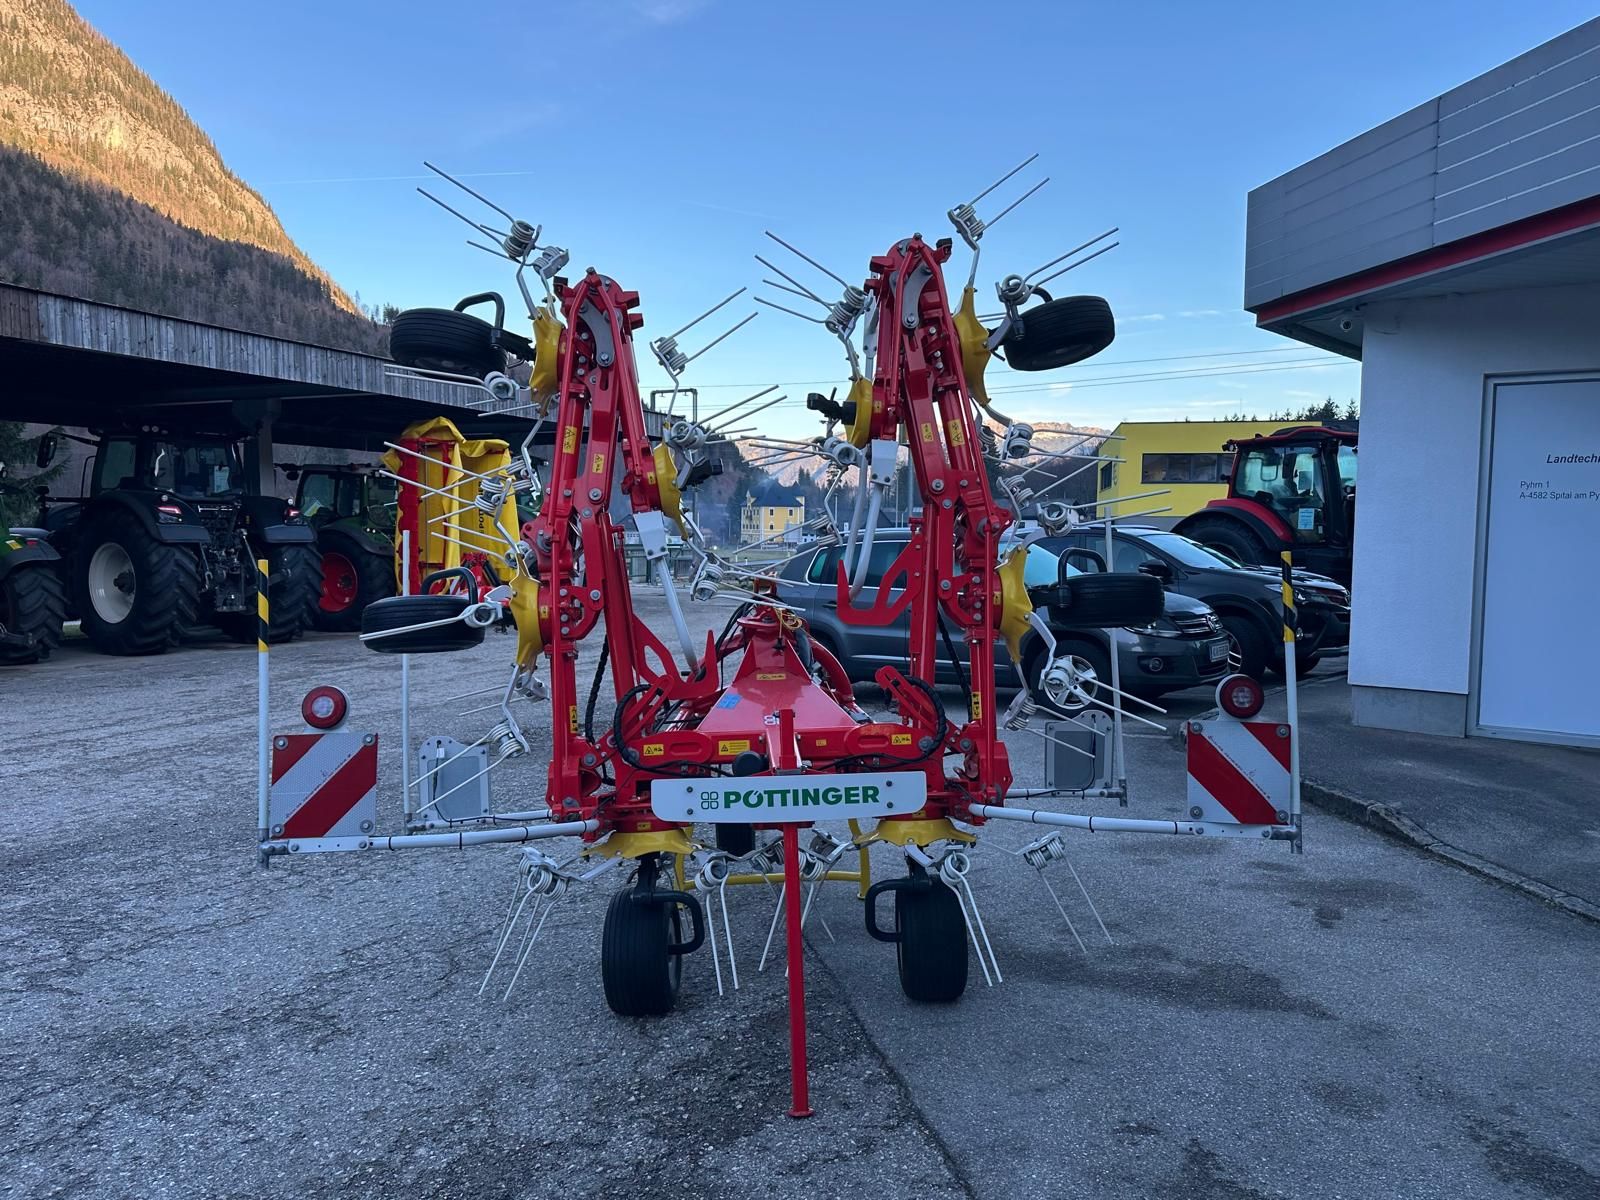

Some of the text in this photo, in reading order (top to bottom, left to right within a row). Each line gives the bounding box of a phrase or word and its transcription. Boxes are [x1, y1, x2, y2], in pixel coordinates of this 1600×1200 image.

[1519, 491, 1548, 499] A-4582
[1549, 491, 1572, 500] Spital
[723, 785, 880, 809] PÖTTINGER
